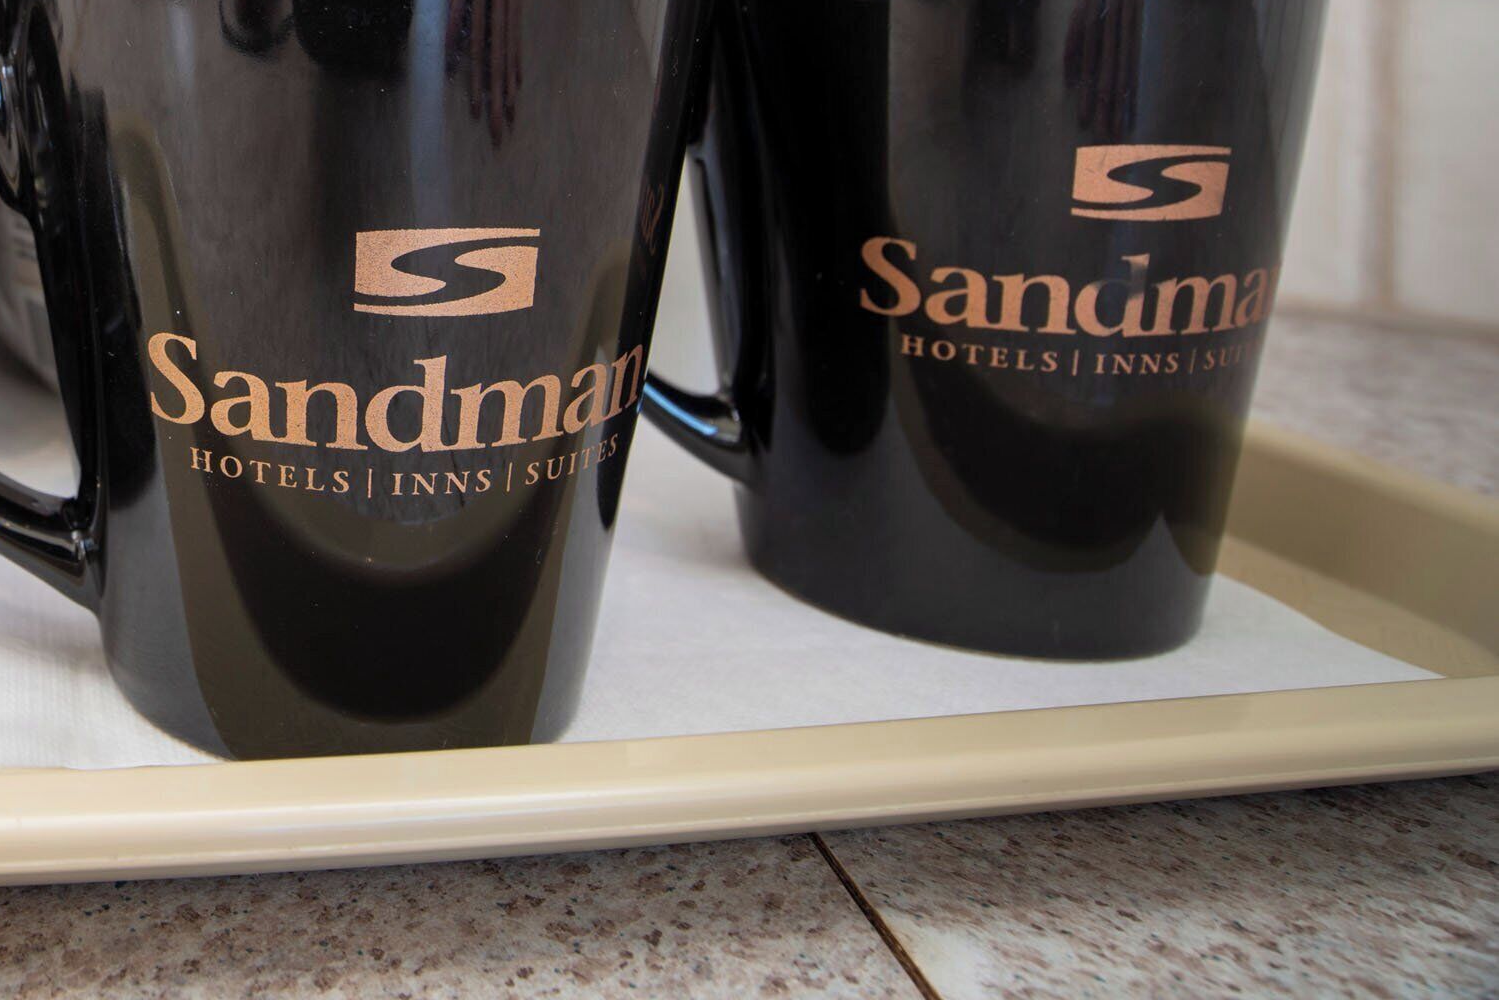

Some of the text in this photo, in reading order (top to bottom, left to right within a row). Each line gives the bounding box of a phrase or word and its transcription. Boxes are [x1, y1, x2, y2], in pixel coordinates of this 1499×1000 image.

[902, 333, 1059, 373] HOTELS
[1094, 351, 1180, 375] INNS
[147, 331, 644, 454] Sandman
[190, 433, 620, 496] HOTELS INNS SUITES
